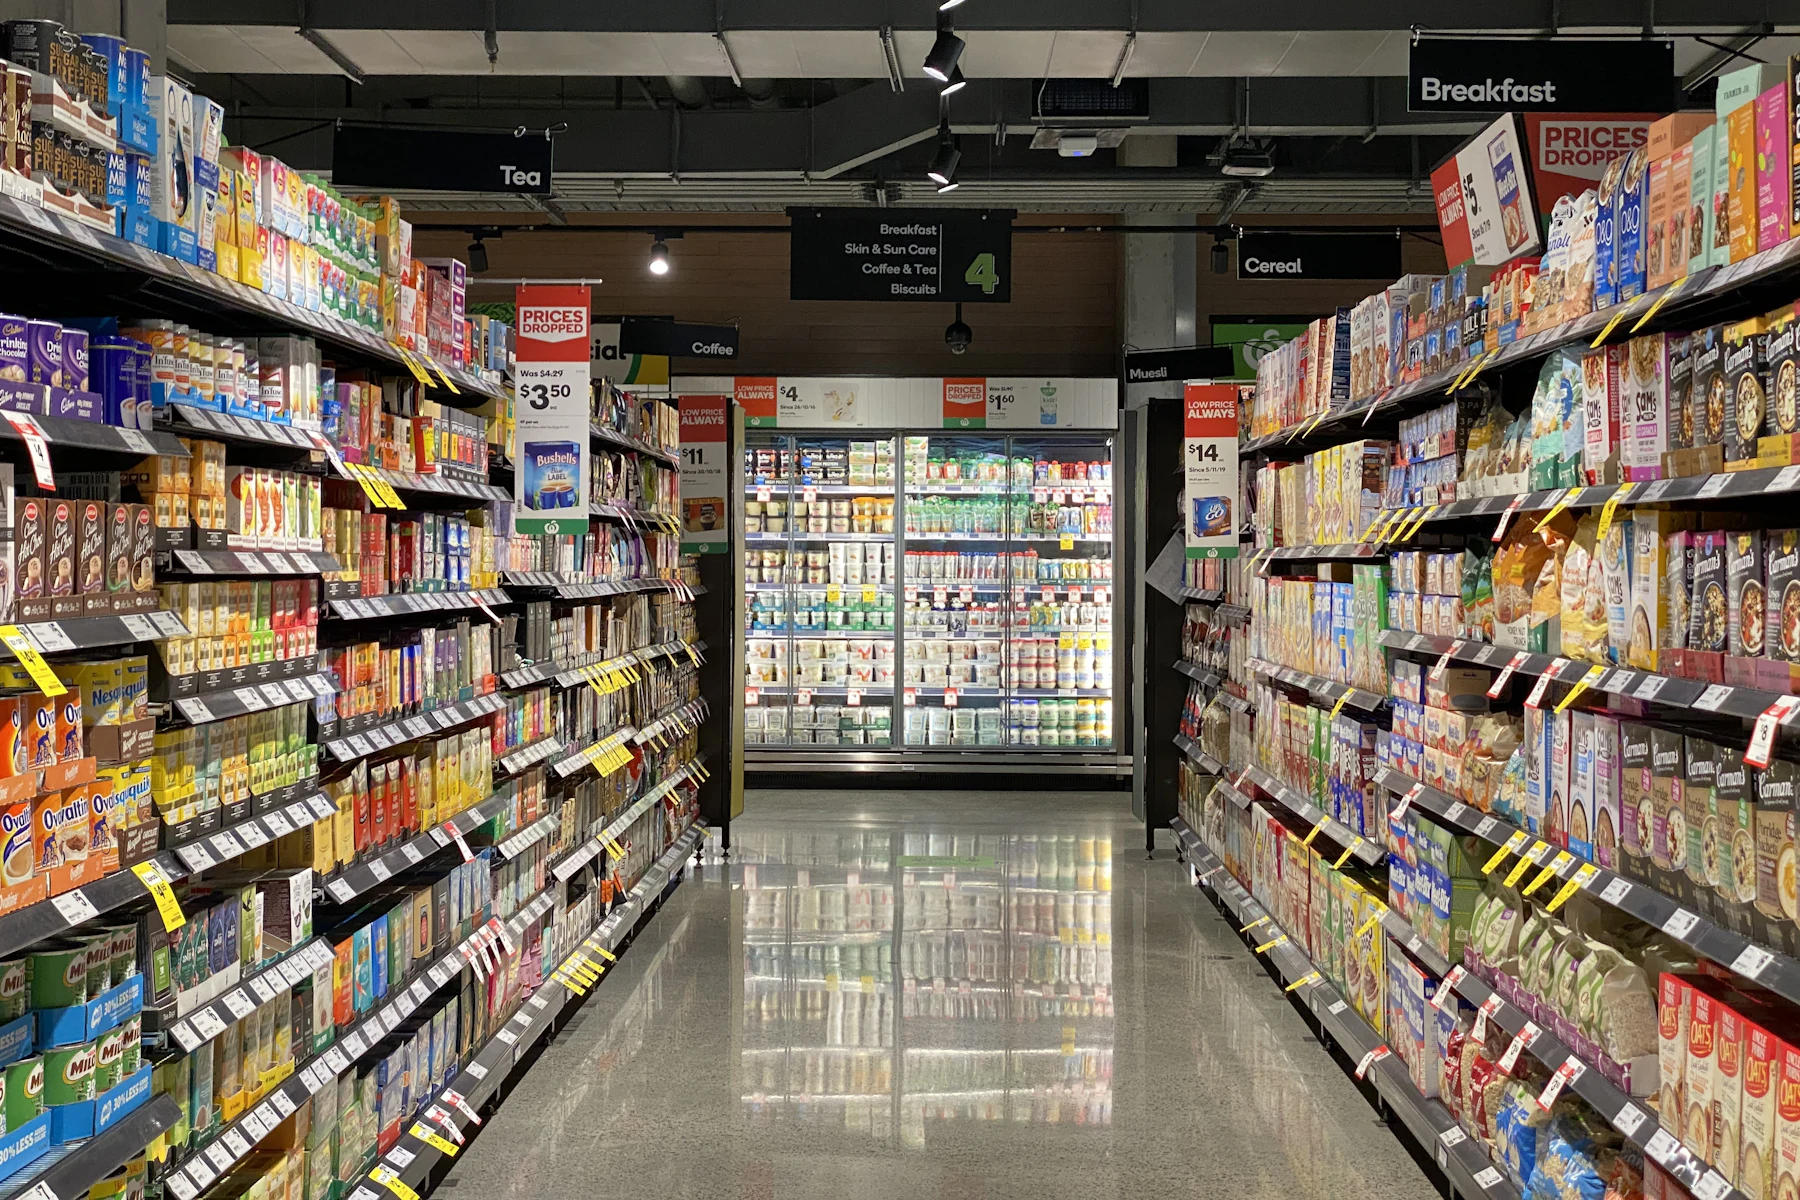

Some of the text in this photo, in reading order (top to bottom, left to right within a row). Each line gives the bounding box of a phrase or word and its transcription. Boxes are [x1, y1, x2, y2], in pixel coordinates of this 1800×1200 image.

[1421, 77, 1556, 103] Breakfast
[1545, 127, 1648, 148] PRICES
[1545, 150, 1630, 165] DROPP
[500, 165, 541, 186] Tea
[1438, 181, 1460, 207] LOW PRICE
[1463, 173, 1478, 216] $5
[1441, 199, 1463, 228] ALWAYS
[880, 224, 937, 236] Breakfast
[844, 243, 937, 255] Skin & Sun Care
[862, 263, 936, 275] Coffee & Tea
[964, 252, 999, 294] 4
[1244, 256, 1303, 274] Cereal
[891, 283, 936, 295] Biscuits
[523, 310, 583, 322] PRICES
[523, 324, 583, 333] DROPPED
[691, 341, 734, 356] Coffee
[1766, 324, 1794, 362] Carman's
[1724, 337, 1753, 373] Carman's
[540, 369, 563, 378] $4.29
[1129, 366, 1168, 379] Muesli
[737, 392, 774, 400] ALWAYS
[780, 386, 798, 402] $4
[681, 416, 724, 425] ALWAYS
[1188, 409, 1235, 418] ALWAYS
[536, 452, 576, 467] Bushells
[682, 448, 703, 465] $11
[1188, 444, 1218, 461] $14
[547, 473, 567, 481] LABEL
[1205, 509, 1224, 520] GO
[1728, 549, 1754, 575] Carman's
[1768, 547, 1798, 575] Carman's
[1622, 736, 1648, 758] Carman's
[1653, 743, 1679, 766] Carman's
[1716, 763, 1746, 788] Carman's
[1757, 818, 1782, 842] Porridge
[116, 989, 129, 1007] LESS
[1660, 1004, 1676, 1029] OATS
[1691, 1021, 1712, 1046] OATS
[1720, 1038, 1737, 1062] OATS
[1746, 1057, 1767, 1085] OATS
[114, 1084, 139, 1111] 30% LESS
[16, 1132, 34, 1154] LESS
